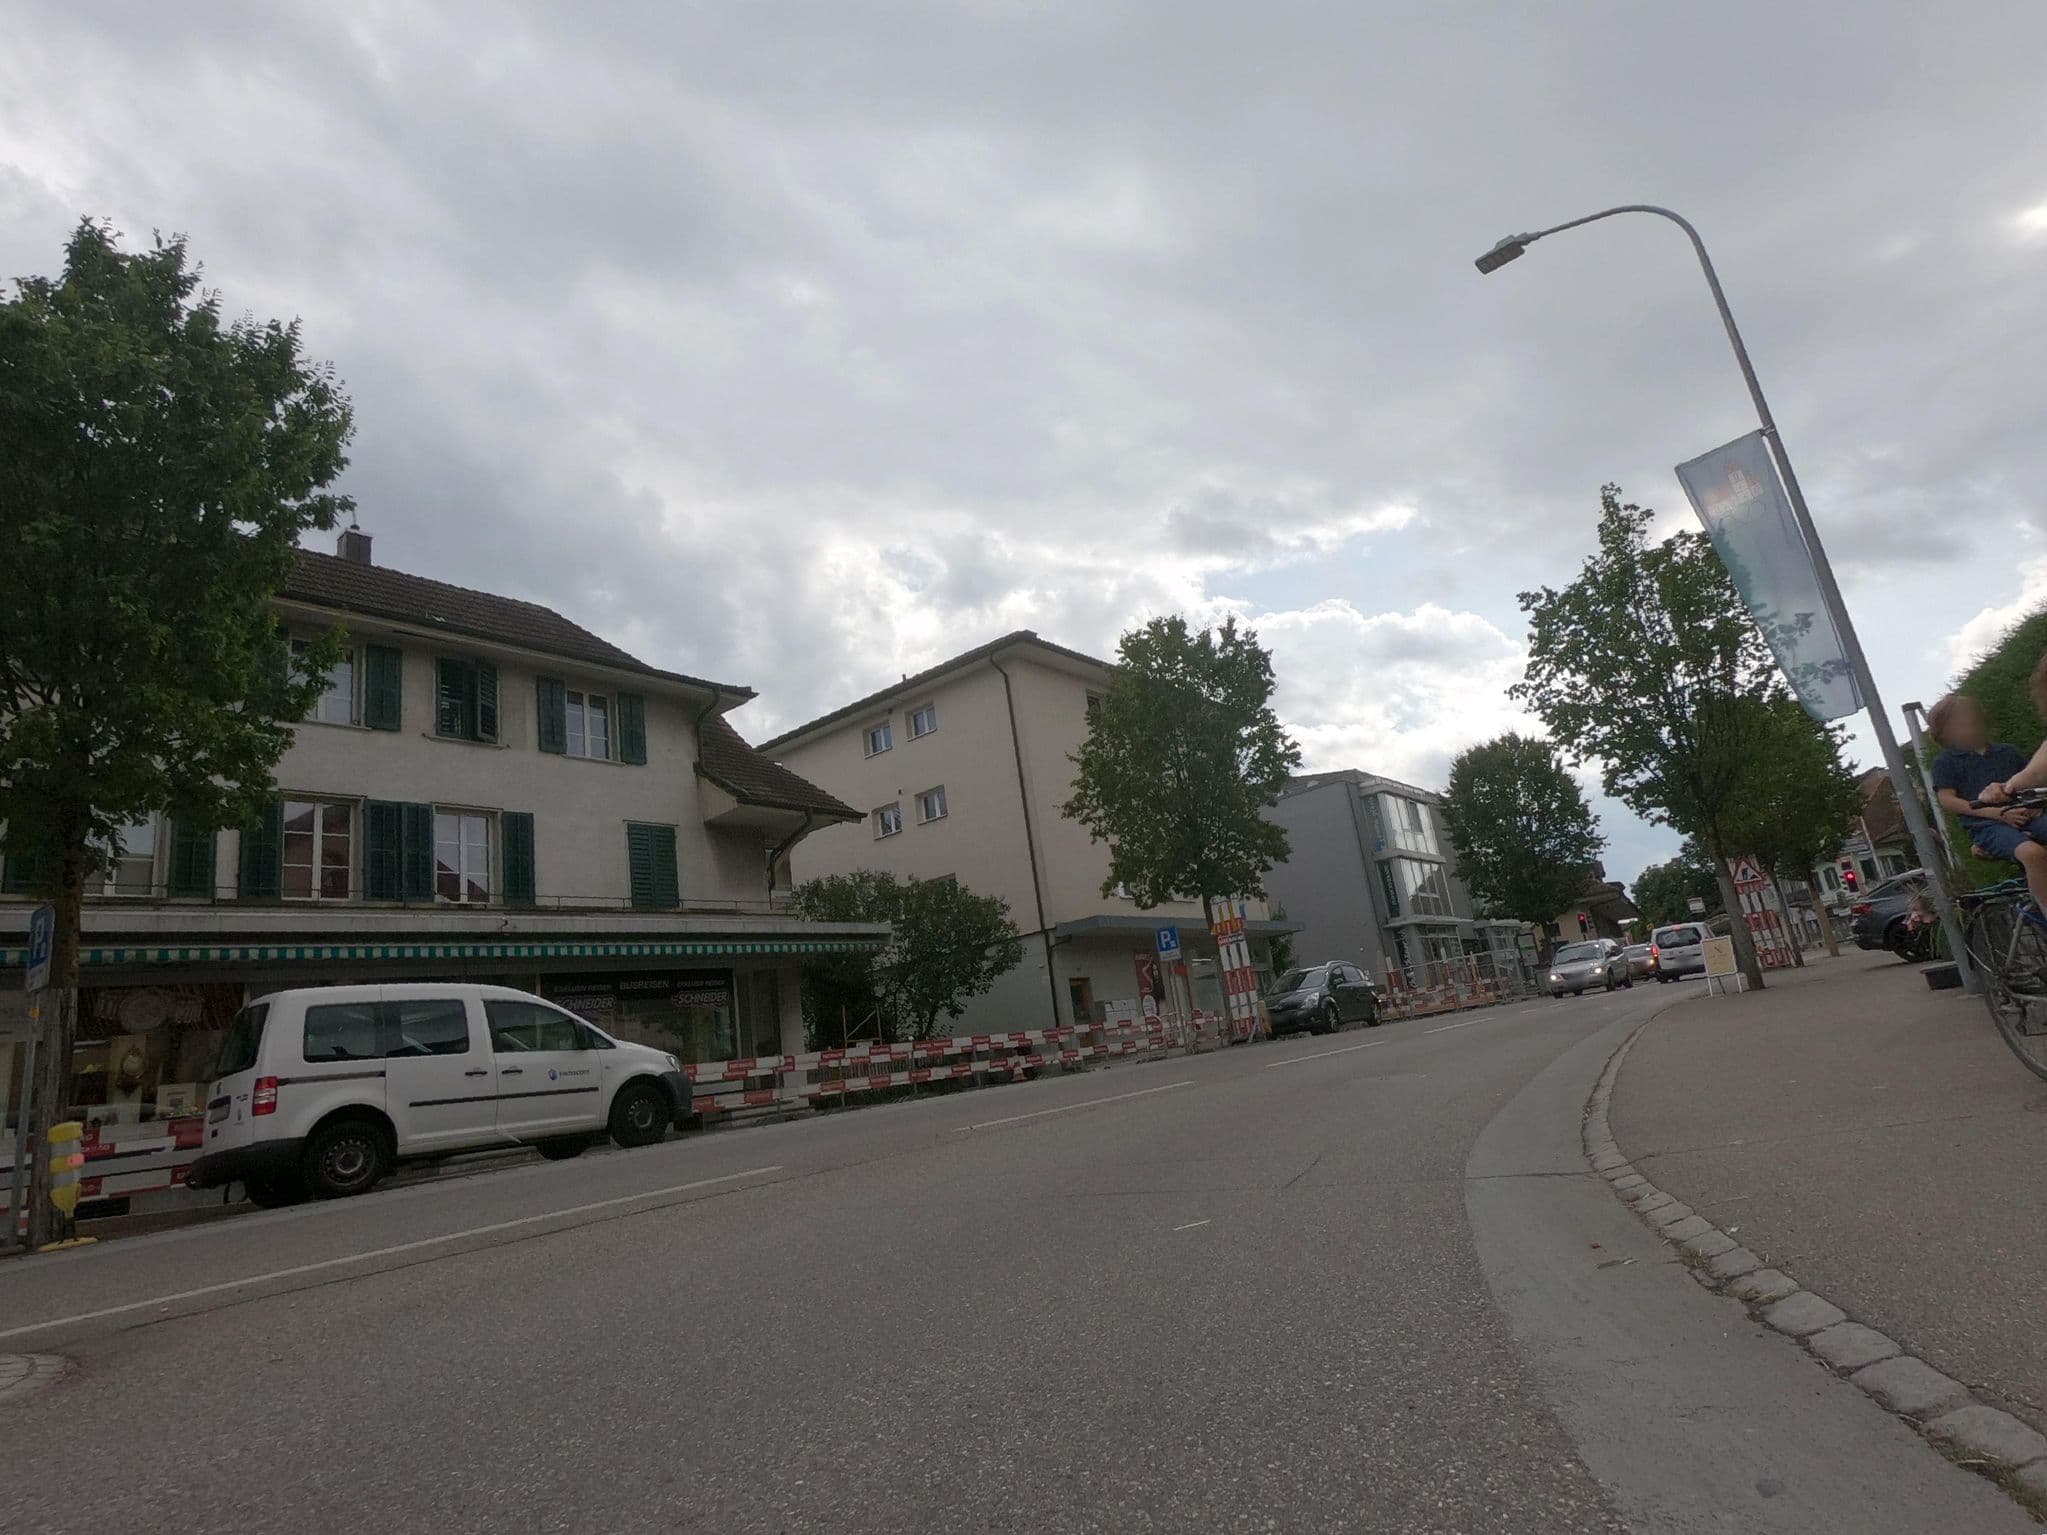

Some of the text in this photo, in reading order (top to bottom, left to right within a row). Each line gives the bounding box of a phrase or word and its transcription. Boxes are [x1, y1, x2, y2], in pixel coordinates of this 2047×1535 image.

[33, 917, 45, 959] P
[1160, 930, 1171, 949] P
[678, 991, 729, 1004] SCHNEIDER
